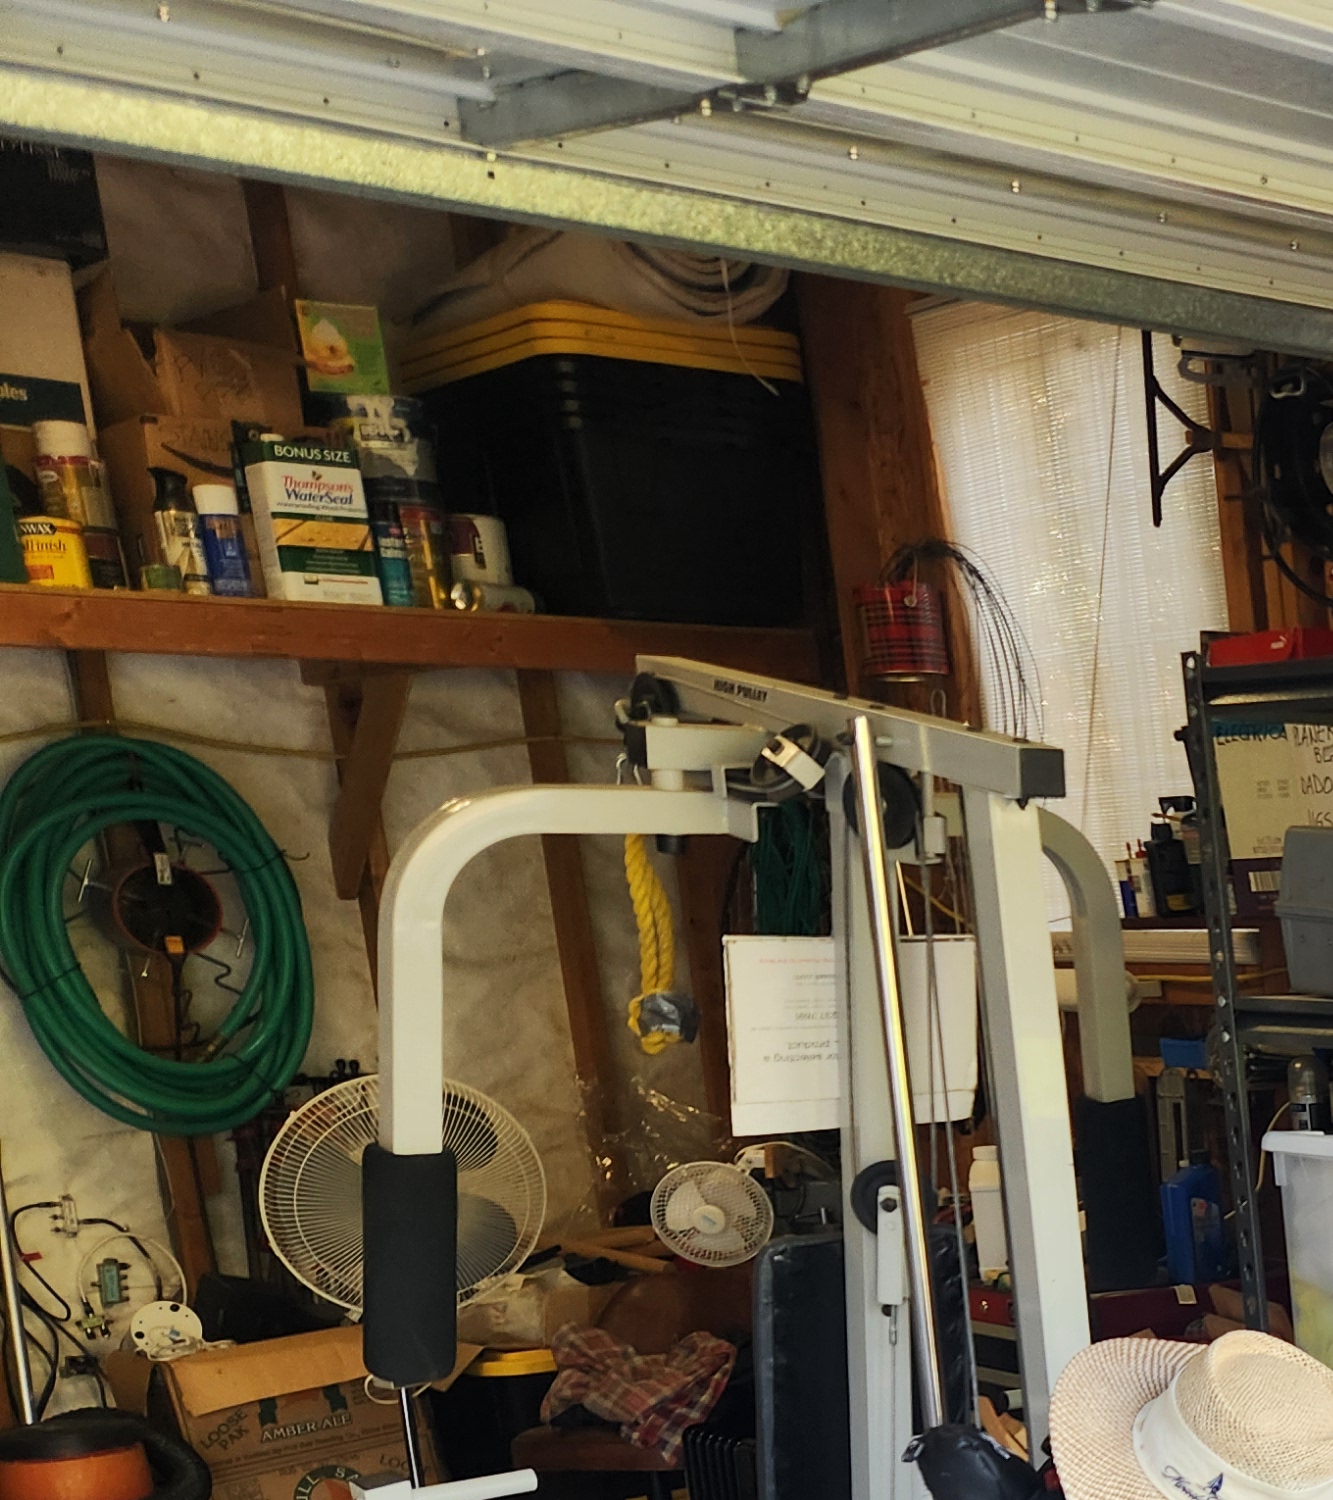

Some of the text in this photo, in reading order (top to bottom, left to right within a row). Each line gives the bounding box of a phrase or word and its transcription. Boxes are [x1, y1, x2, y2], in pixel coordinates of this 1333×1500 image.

[274, 445, 351, 463] BONUS SIZE
[285, 489, 353, 505] WaterSeal
[714, 680, 768, 702] HIGH PULLEY
[200, 1409, 249, 1450] LOOSE
[218, 1426, 249, 1451] PAK
[261, 1413, 353, 1443] AMBER ALE
